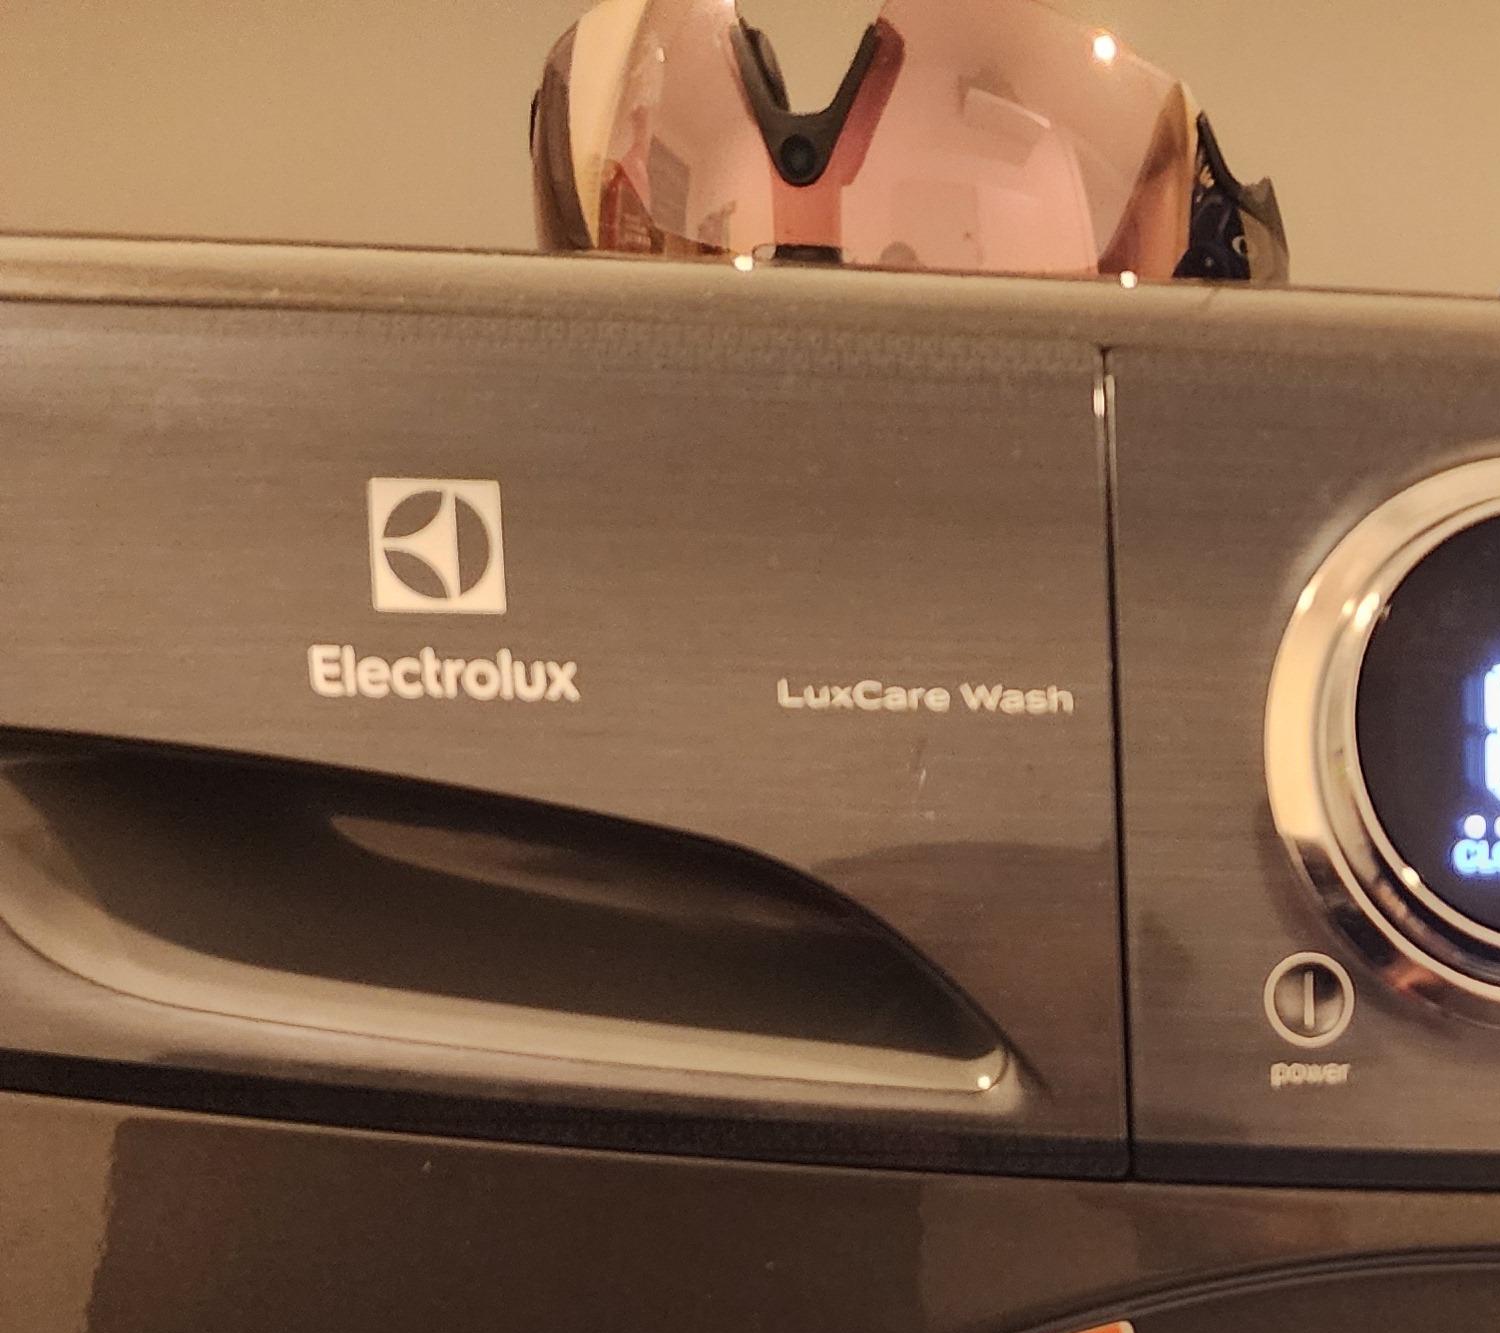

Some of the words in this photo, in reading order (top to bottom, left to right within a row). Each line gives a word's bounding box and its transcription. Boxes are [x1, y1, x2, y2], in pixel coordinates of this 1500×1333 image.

[308, 643, 582, 703] Electrolux
[775, 676, 951, 714] LuxCare
[959, 682, 1076, 717] Wash
[1270, 1060, 1350, 1088] power
